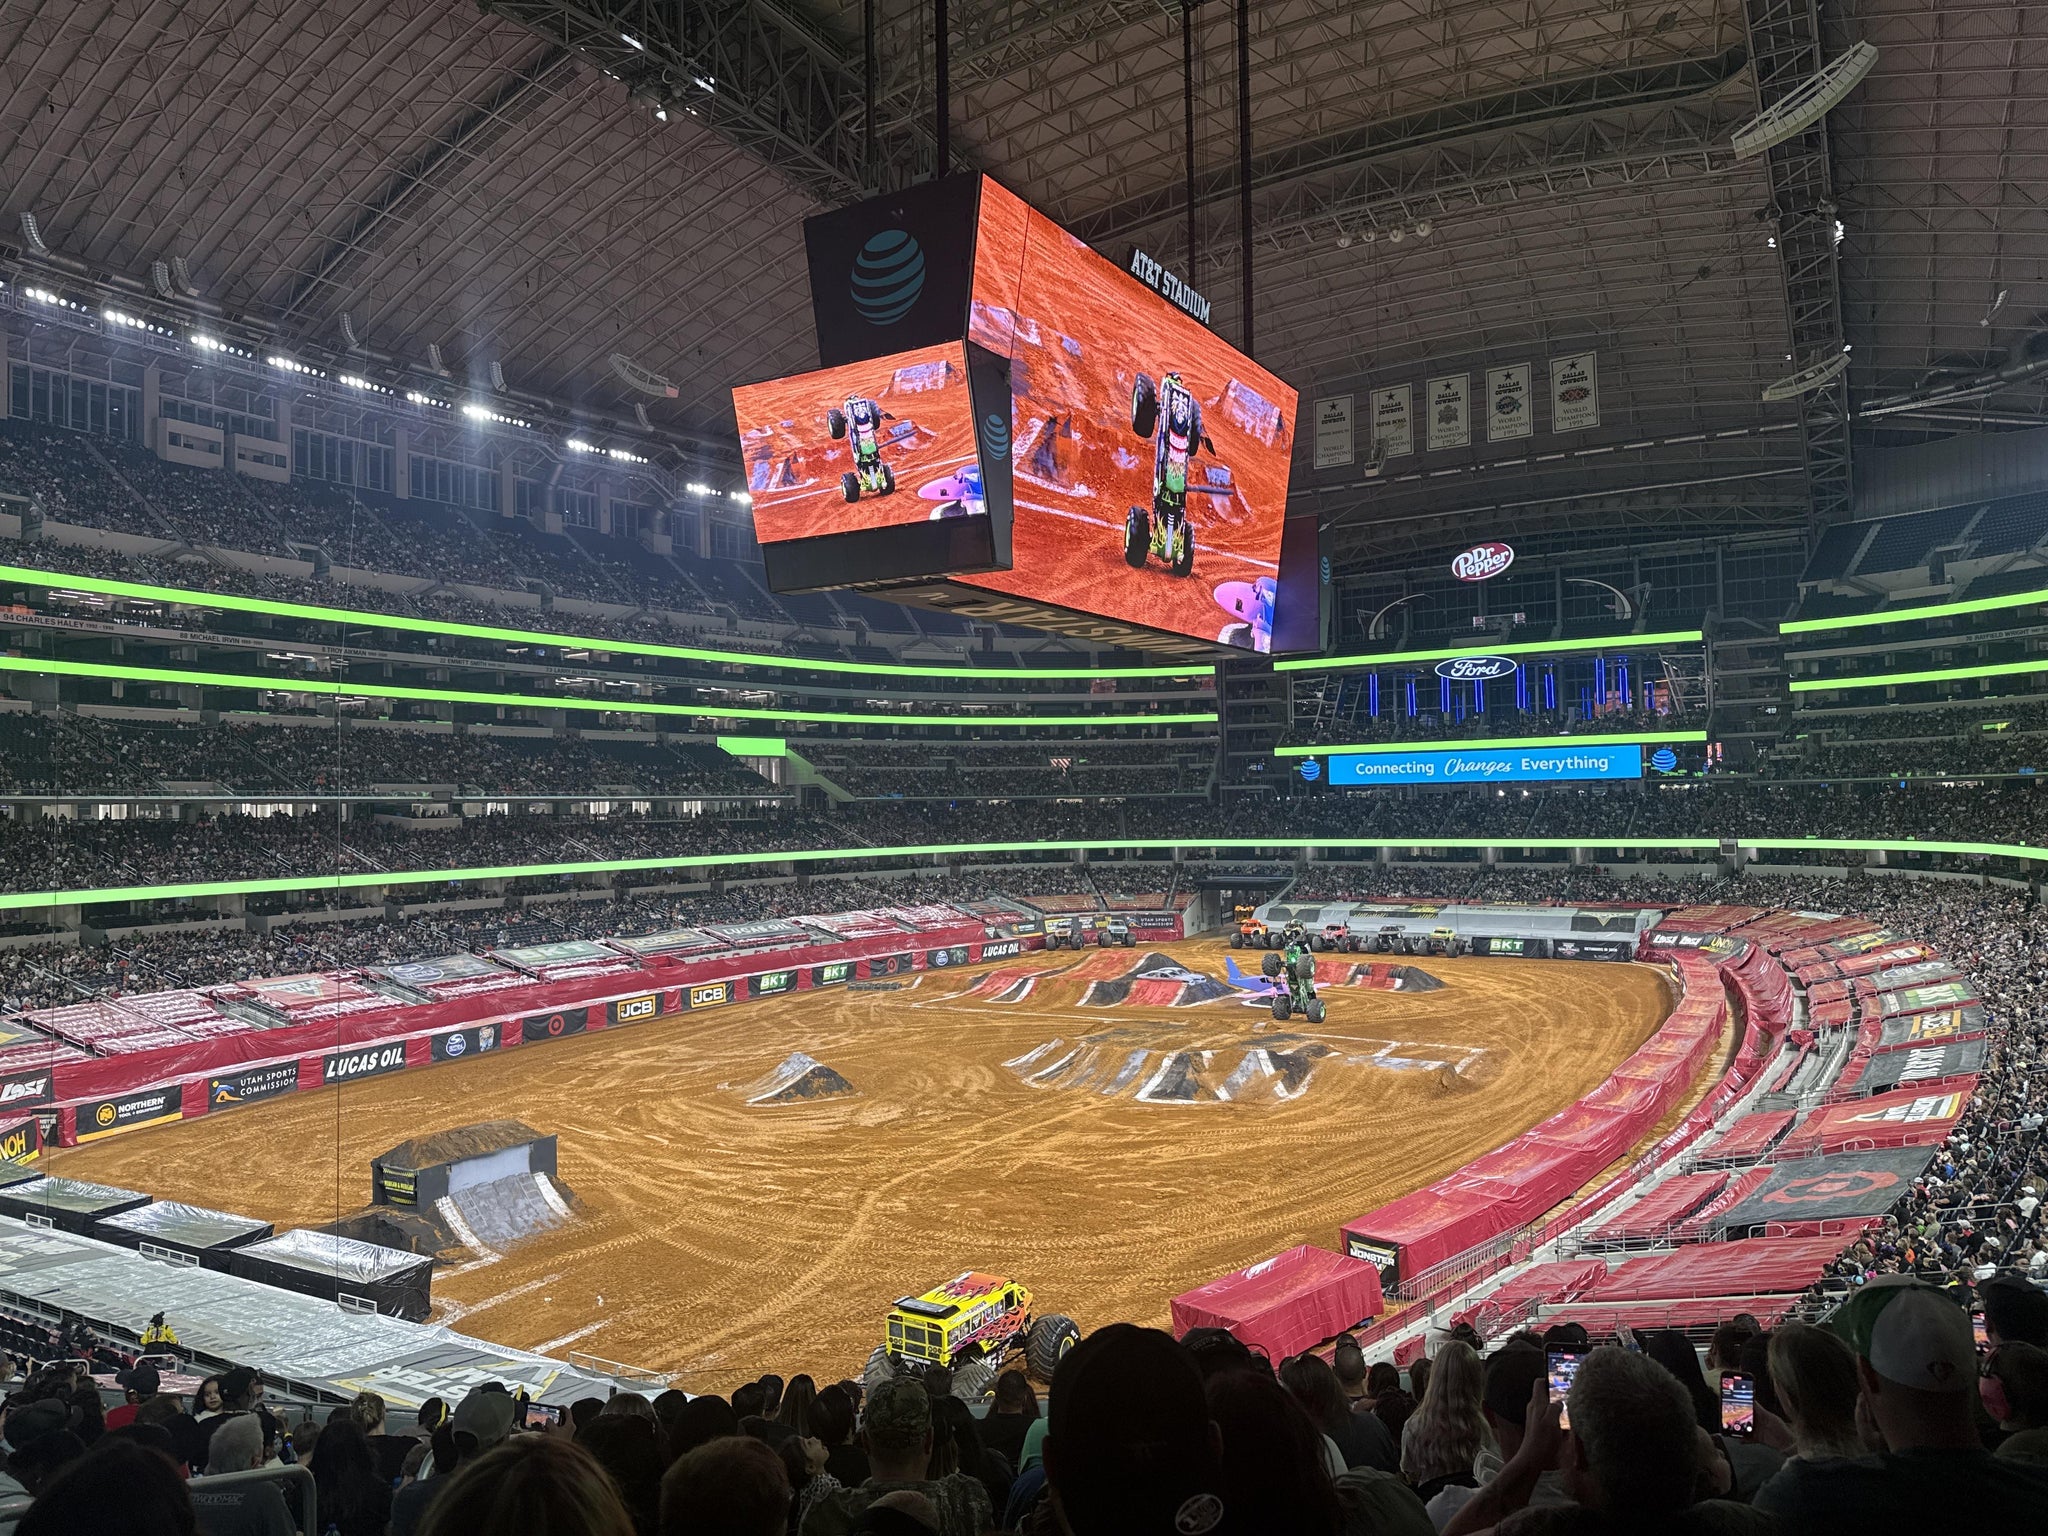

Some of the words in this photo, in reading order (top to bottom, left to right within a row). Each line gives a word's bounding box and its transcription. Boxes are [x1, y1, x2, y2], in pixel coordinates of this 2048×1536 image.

[1131, 248, 1162, 289] AT&T
[1162, 270, 1211, 325] STADIUM
[1560, 376, 1588, 385] COWBOYS
[1562, 371, 1585, 379] DALLAS
[1495, 386, 1522, 395] COWBOYS
[1498, 381, 1520, 389] DALLAS
[1438, 391, 1459, 399] DALLAS
[1381, 401, 1401, 409] DALLAS
[1435, 397, 1461, 405] COWBOYS
[1324, 411, 1343, 419] DALLAS
[1378, 407, 1404, 415] COWBOYS
[1563, 406, 1588, 414] WORLD
[1321, 416, 1346, 425] COWBOYS
[1498, 416, 1522, 424] WORLD
[1556, 411, 1595, 422] CHAMPIONS
[1437, 425, 1460, 433] WORLD
[1491, 421, 1529, 432] CHAMPIONS
[1430, 431, 1467, 441] CHAMPIONS
[1472, 547, 1495, 563] Dr
[1456, 551, 1510, 578] Pepper
[3, 613, 14, 621] 94
[16, 614, 56, 625] CHARLES
[57, 619, 84, 628] HALEY
[190, 633, 220, 642] MICHAEL
[327, 646, 342, 654] TROY
[344, 648, 367, 656] AIKMAN
[1450, 660, 1500, 677] Ford
[1356, 762, 1434, 776] Connecting
[1444, 758, 1513, 777] Changes
[983, 944, 1007, 957] LUCAS
[1008, 943, 1019, 954] OIL
[1490, 939, 1524, 951] BKT
[823, 964, 848, 980] BKT
[761, 974, 787, 990] BKT
[694, 988, 723, 1004] JCB
[620, 1000, 653, 1018] JCB
[326, 1052, 379, 1078] LUCAS
[380, 1047, 404, 1067] OIL
[240, 1075, 263, 1086] UTAH
[266, 1067, 296, 1081] SPORTS
[240, 1077, 296, 1096] COMMISSION
[1350, 1248, 1395, 1266] MONSTER
